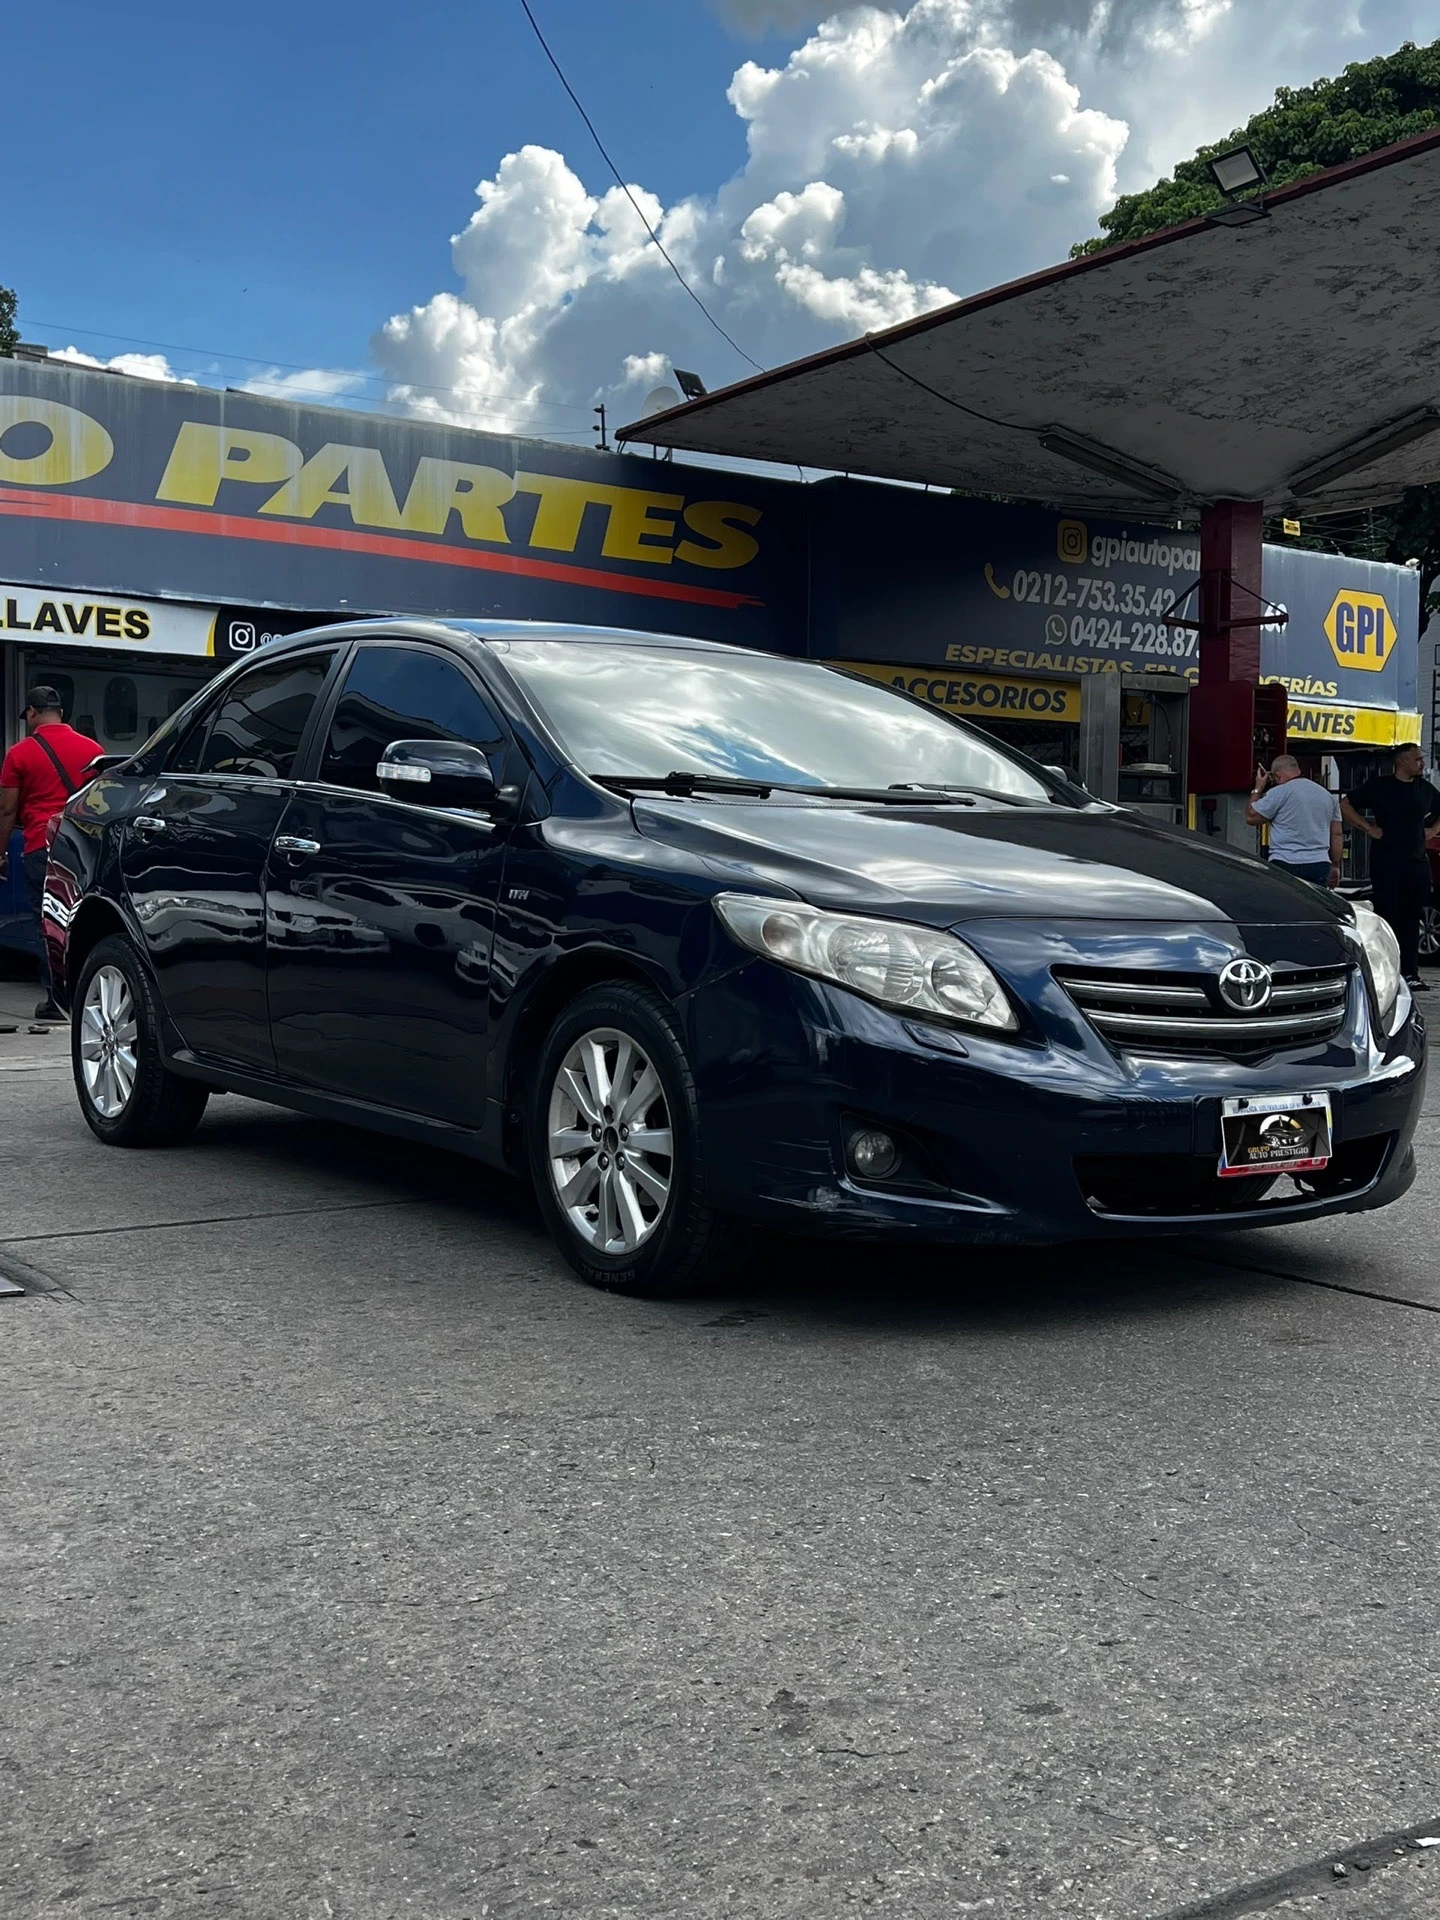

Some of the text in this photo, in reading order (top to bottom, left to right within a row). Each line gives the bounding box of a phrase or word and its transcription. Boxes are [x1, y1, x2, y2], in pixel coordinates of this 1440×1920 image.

[155, 421, 763, 570] PARTES
[0, 598, 151, 640] LAVES
[1336, 601, 1384, 657] GPI
[944, 643, 1133, 674] ESPECIALISTAS
[890, 676, 1067, 713] ACCESORIOS
[1287, 709, 1356, 736] ANTES
[1247, 1145, 1270, 1153] GRUPO
[1248, 1147, 1309, 1160] AUTO PRESTIGIO
